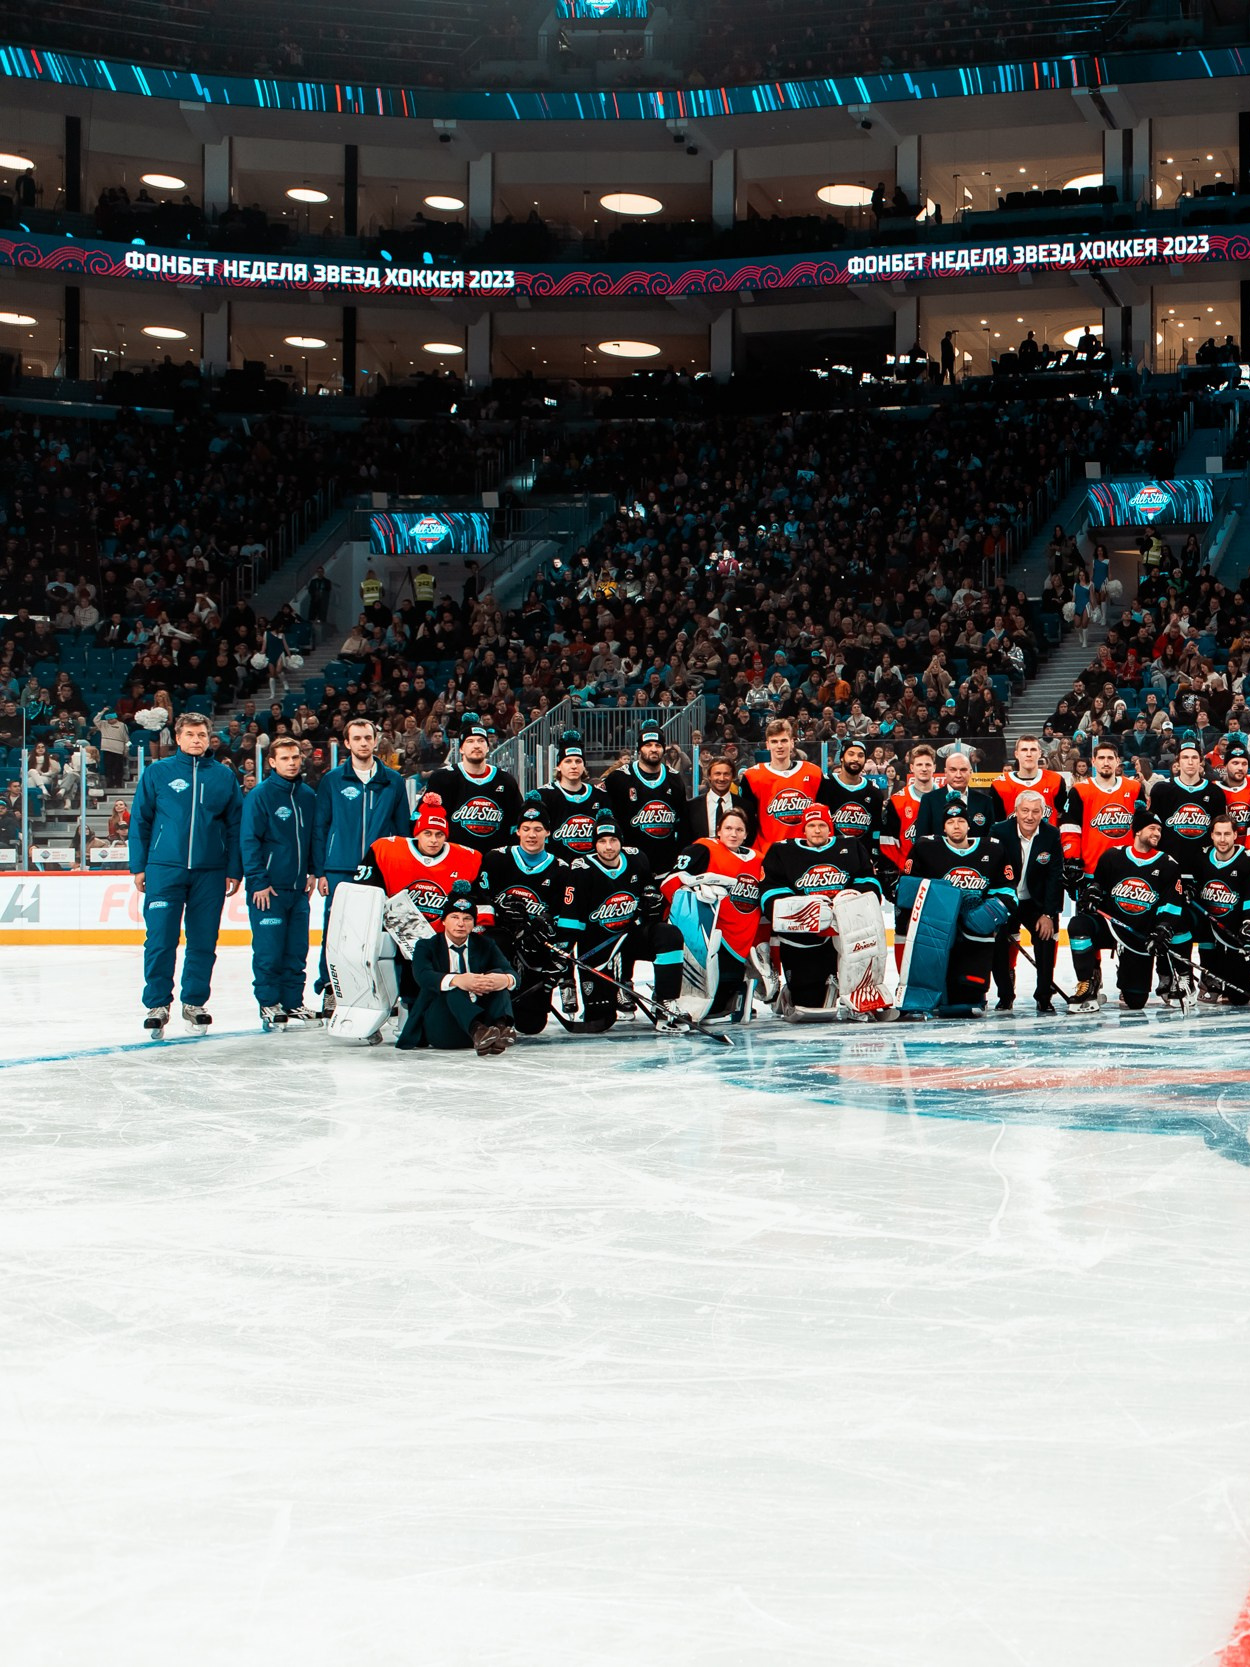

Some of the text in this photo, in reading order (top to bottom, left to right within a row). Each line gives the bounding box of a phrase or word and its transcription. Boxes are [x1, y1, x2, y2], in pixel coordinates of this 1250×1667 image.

[847, 234, 1210, 275] ФОНБЕТ НЕДЕЛЯ ЗВЕЗД ХОККЕЯ 2023
[125, 251, 515, 290] ФОНБЕТ НЕДЕЛЯ ЗВЕЗД ХОККЕЯ 2023
[1130, 494, 1169, 504] All-Star
[767, 797, 814, 813] All-Star
[452, 806, 503, 822] All-Star
[632, 810, 676, 824] All-Star
[833, 811, 872, 826] All-Star
[1091, 812, 1134, 827] All-Star
[1167, 812, 1211, 826] All-Star
[554, 824, 593, 838] All-St
[796, 872, 848, 887] All-Star
[564, 886, 575, 905] 5
[1112, 884, 1157, 903] All-Star
[1201, 887, 1238, 904] All-Star
[591, 900, 638, 920] All-Star
[912, 886, 926, 922] CCM
